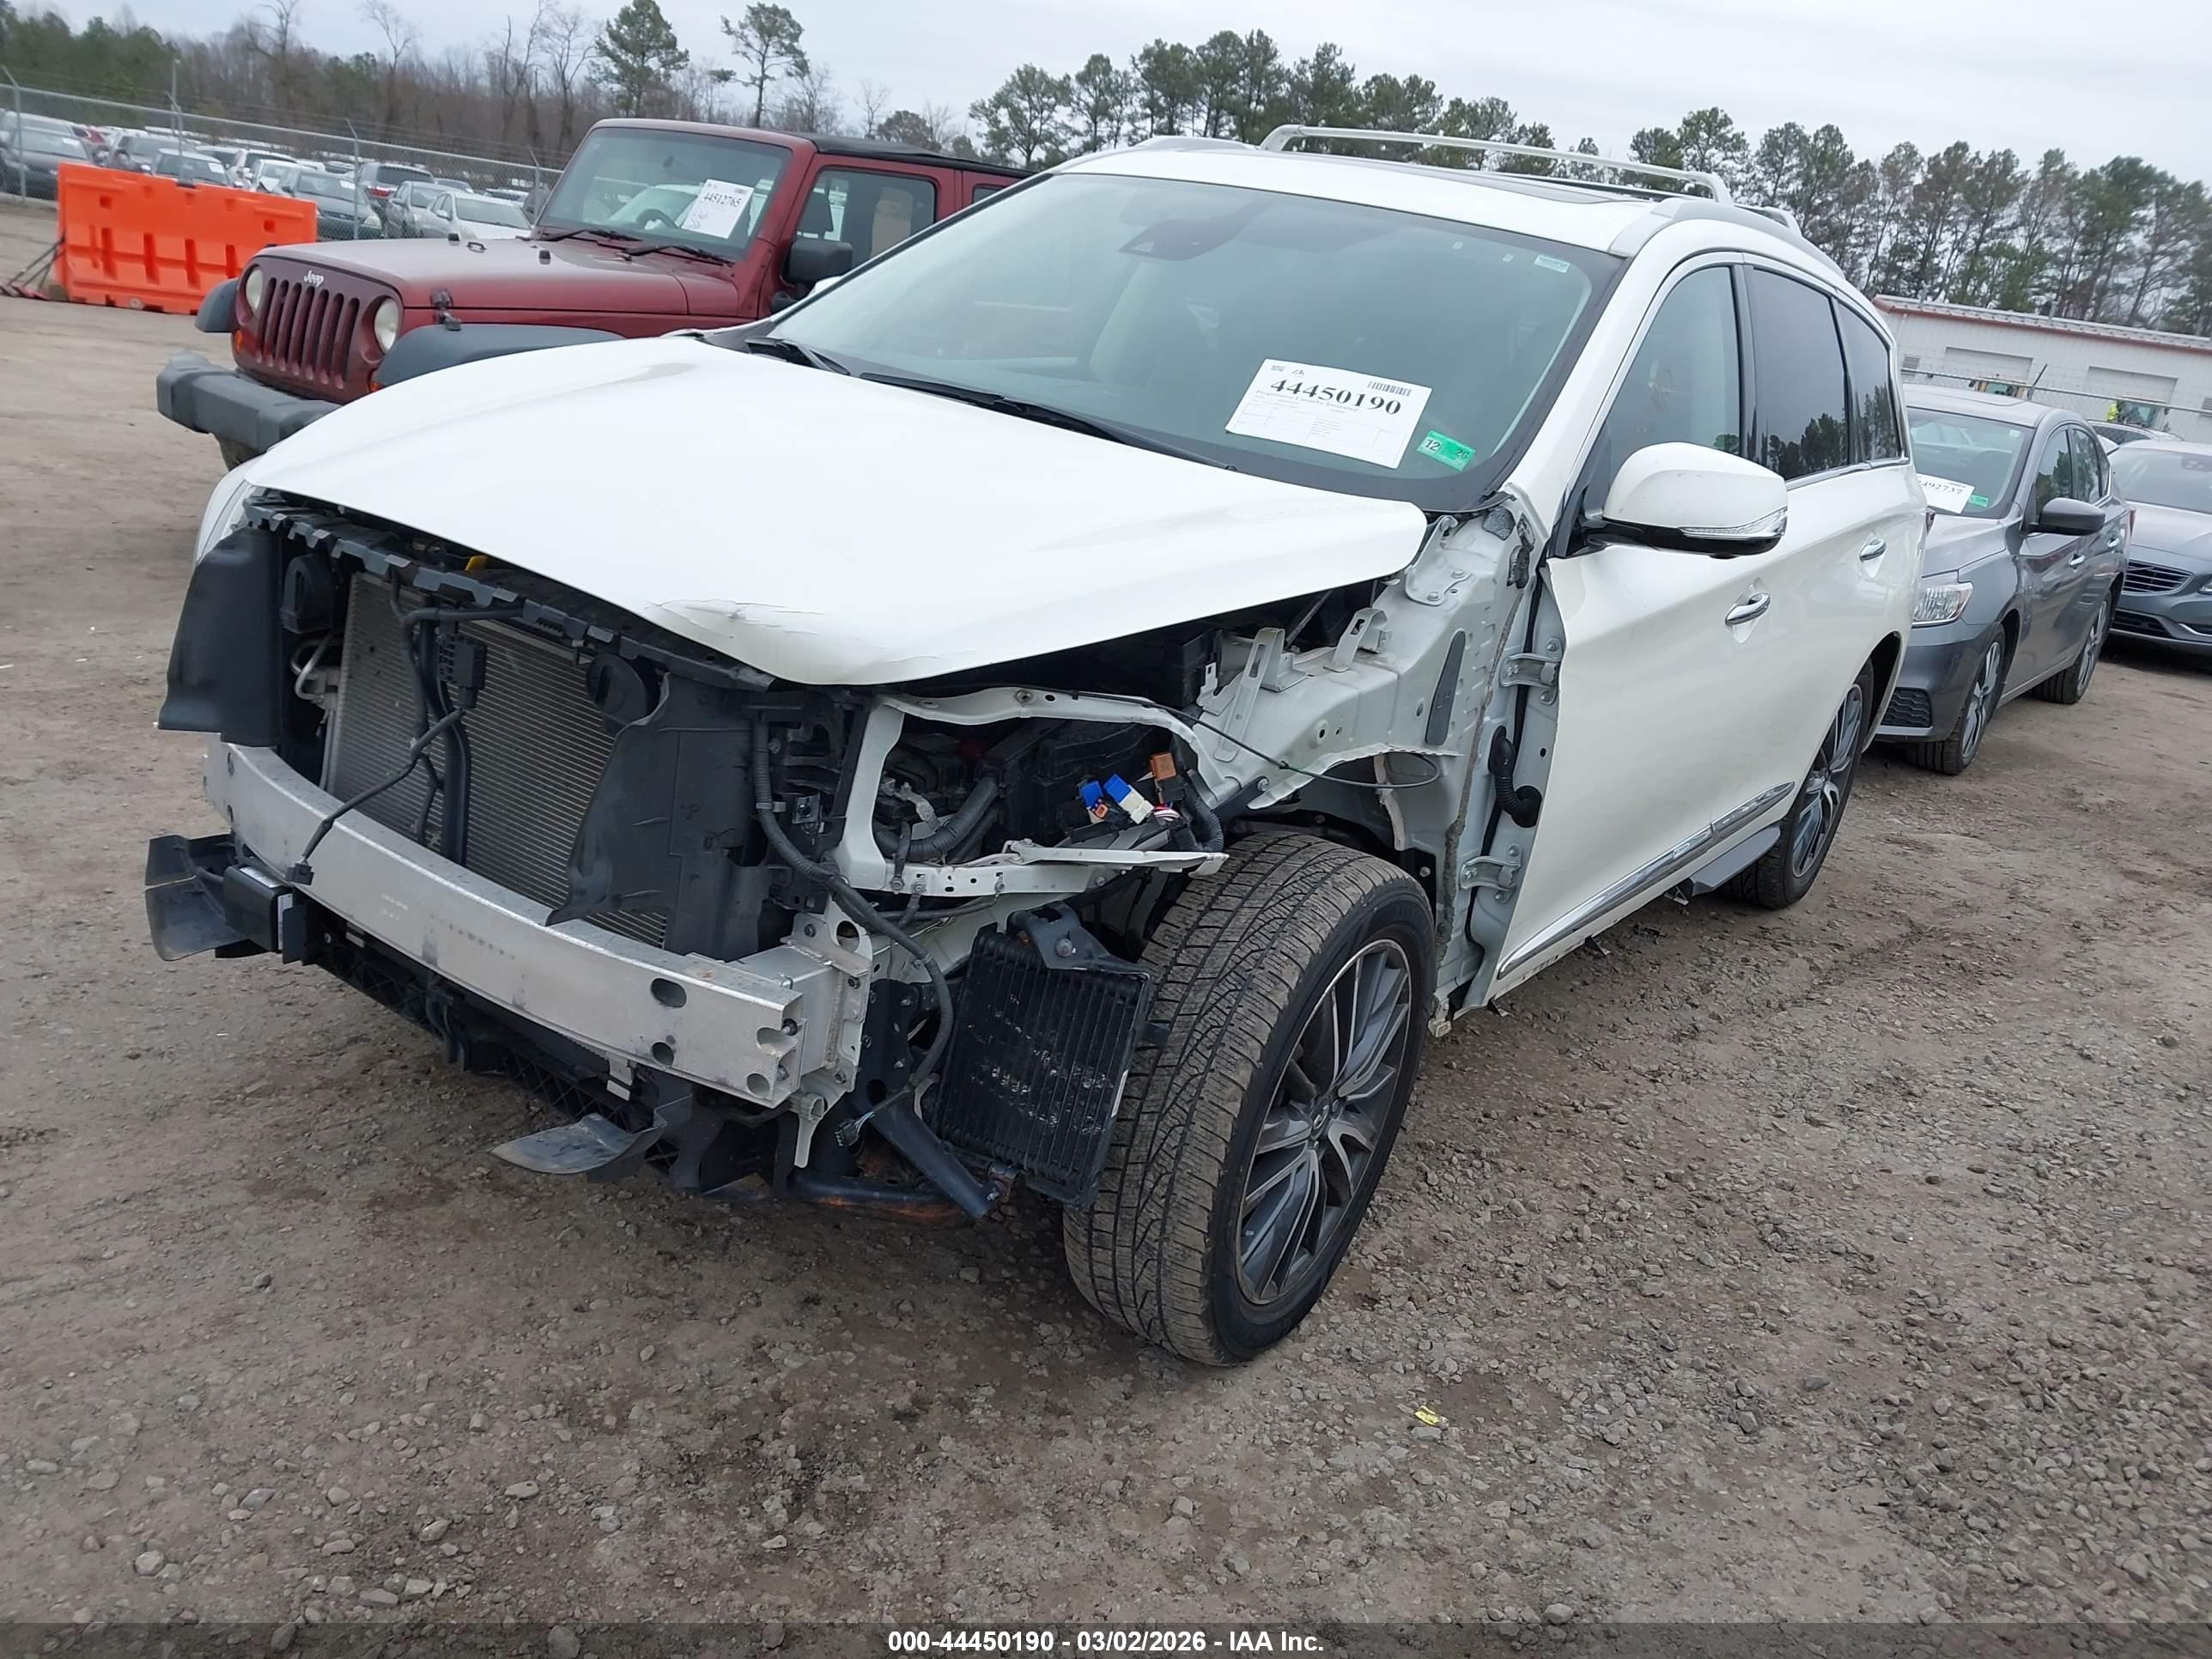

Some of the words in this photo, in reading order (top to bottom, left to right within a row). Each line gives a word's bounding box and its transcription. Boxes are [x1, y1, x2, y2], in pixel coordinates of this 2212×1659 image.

[303, 270, 324, 288] Jeep
[1270, 379, 1401, 415] 44450190
[1425, 439, 1441, 452] 12
